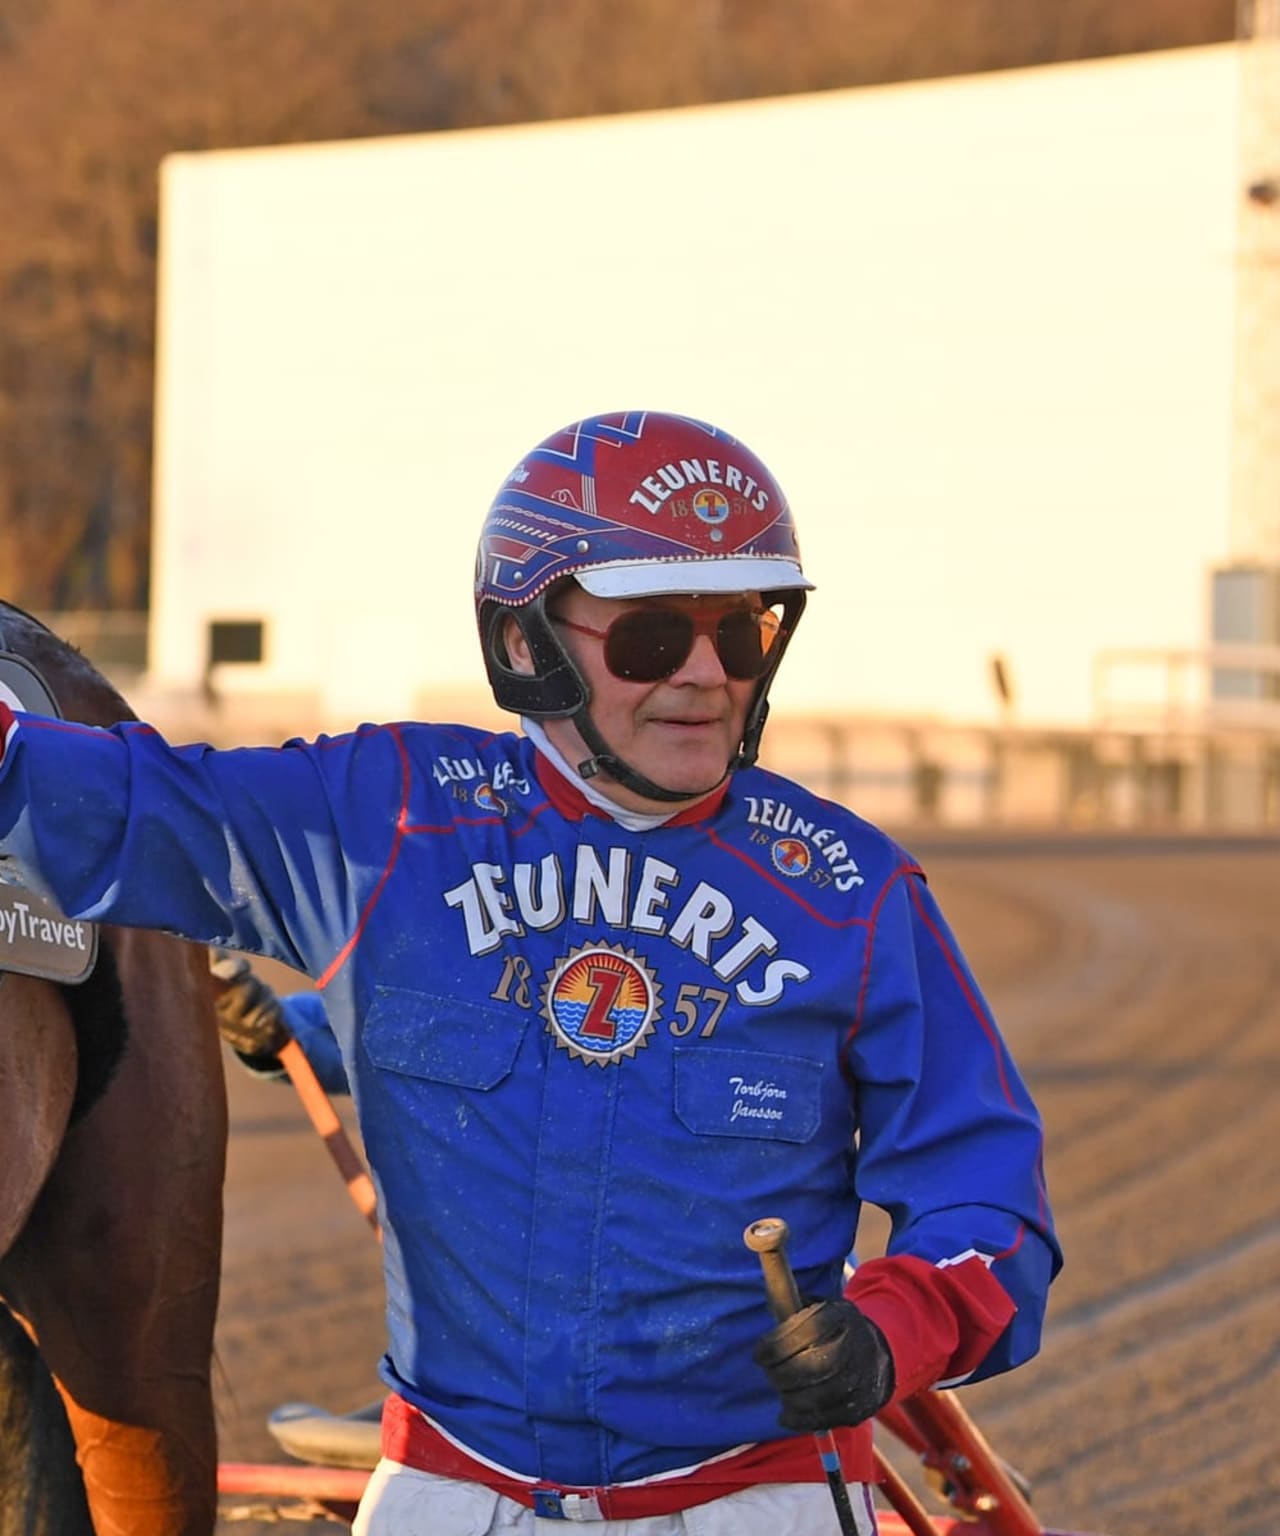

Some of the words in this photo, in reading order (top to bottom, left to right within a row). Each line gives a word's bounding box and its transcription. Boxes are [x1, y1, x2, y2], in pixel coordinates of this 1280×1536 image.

[629, 458, 769, 515] ZEUNERTS
[668, 499, 687, 518] 18
[743, 797, 865, 892] ZEUNERTS
[443, 844, 811, 1007] ZEUNERTS
[490, 955, 533, 1010] 18
[668, 984, 730, 1039] 57
